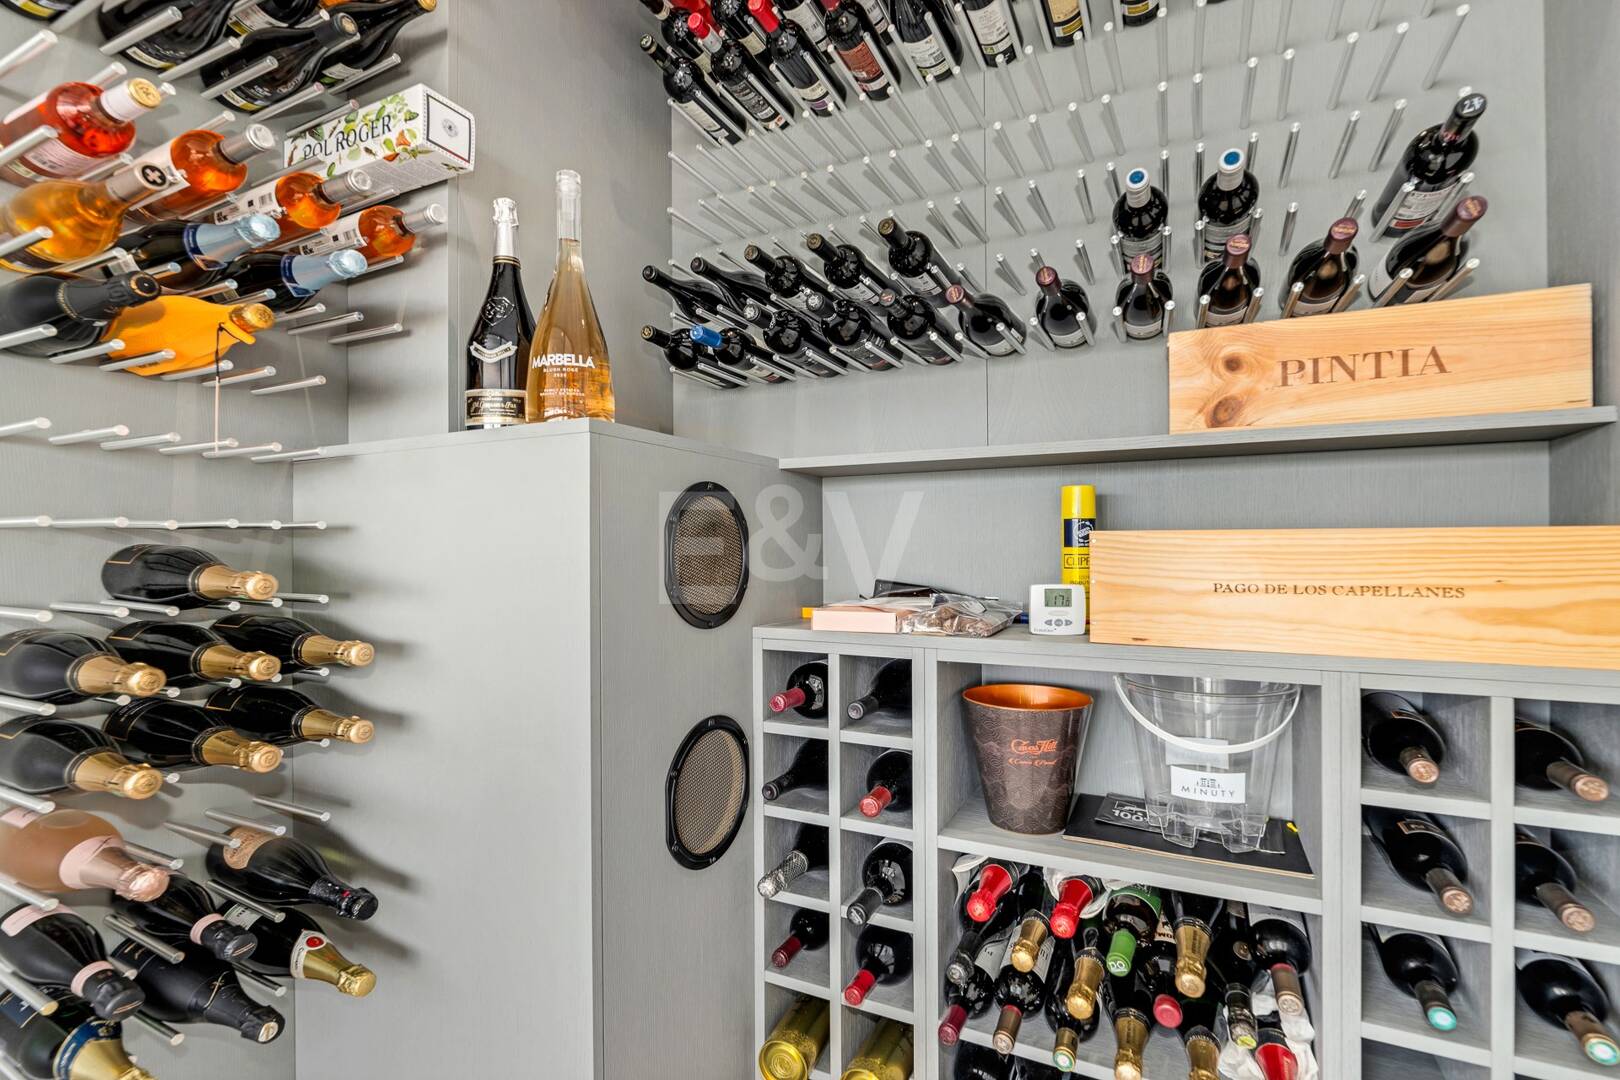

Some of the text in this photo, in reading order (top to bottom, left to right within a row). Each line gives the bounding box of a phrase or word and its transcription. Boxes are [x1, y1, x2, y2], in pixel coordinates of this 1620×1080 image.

[303, 114, 393, 160] POL ROGER
[532, 353, 595, 369] MARBELLA
[1276, 345, 1452, 387] PINTIA
[1213, 582, 1465, 598] PAGO DE LOS CAPELLANES
[1180, 785, 1235, 798] MINUTY
